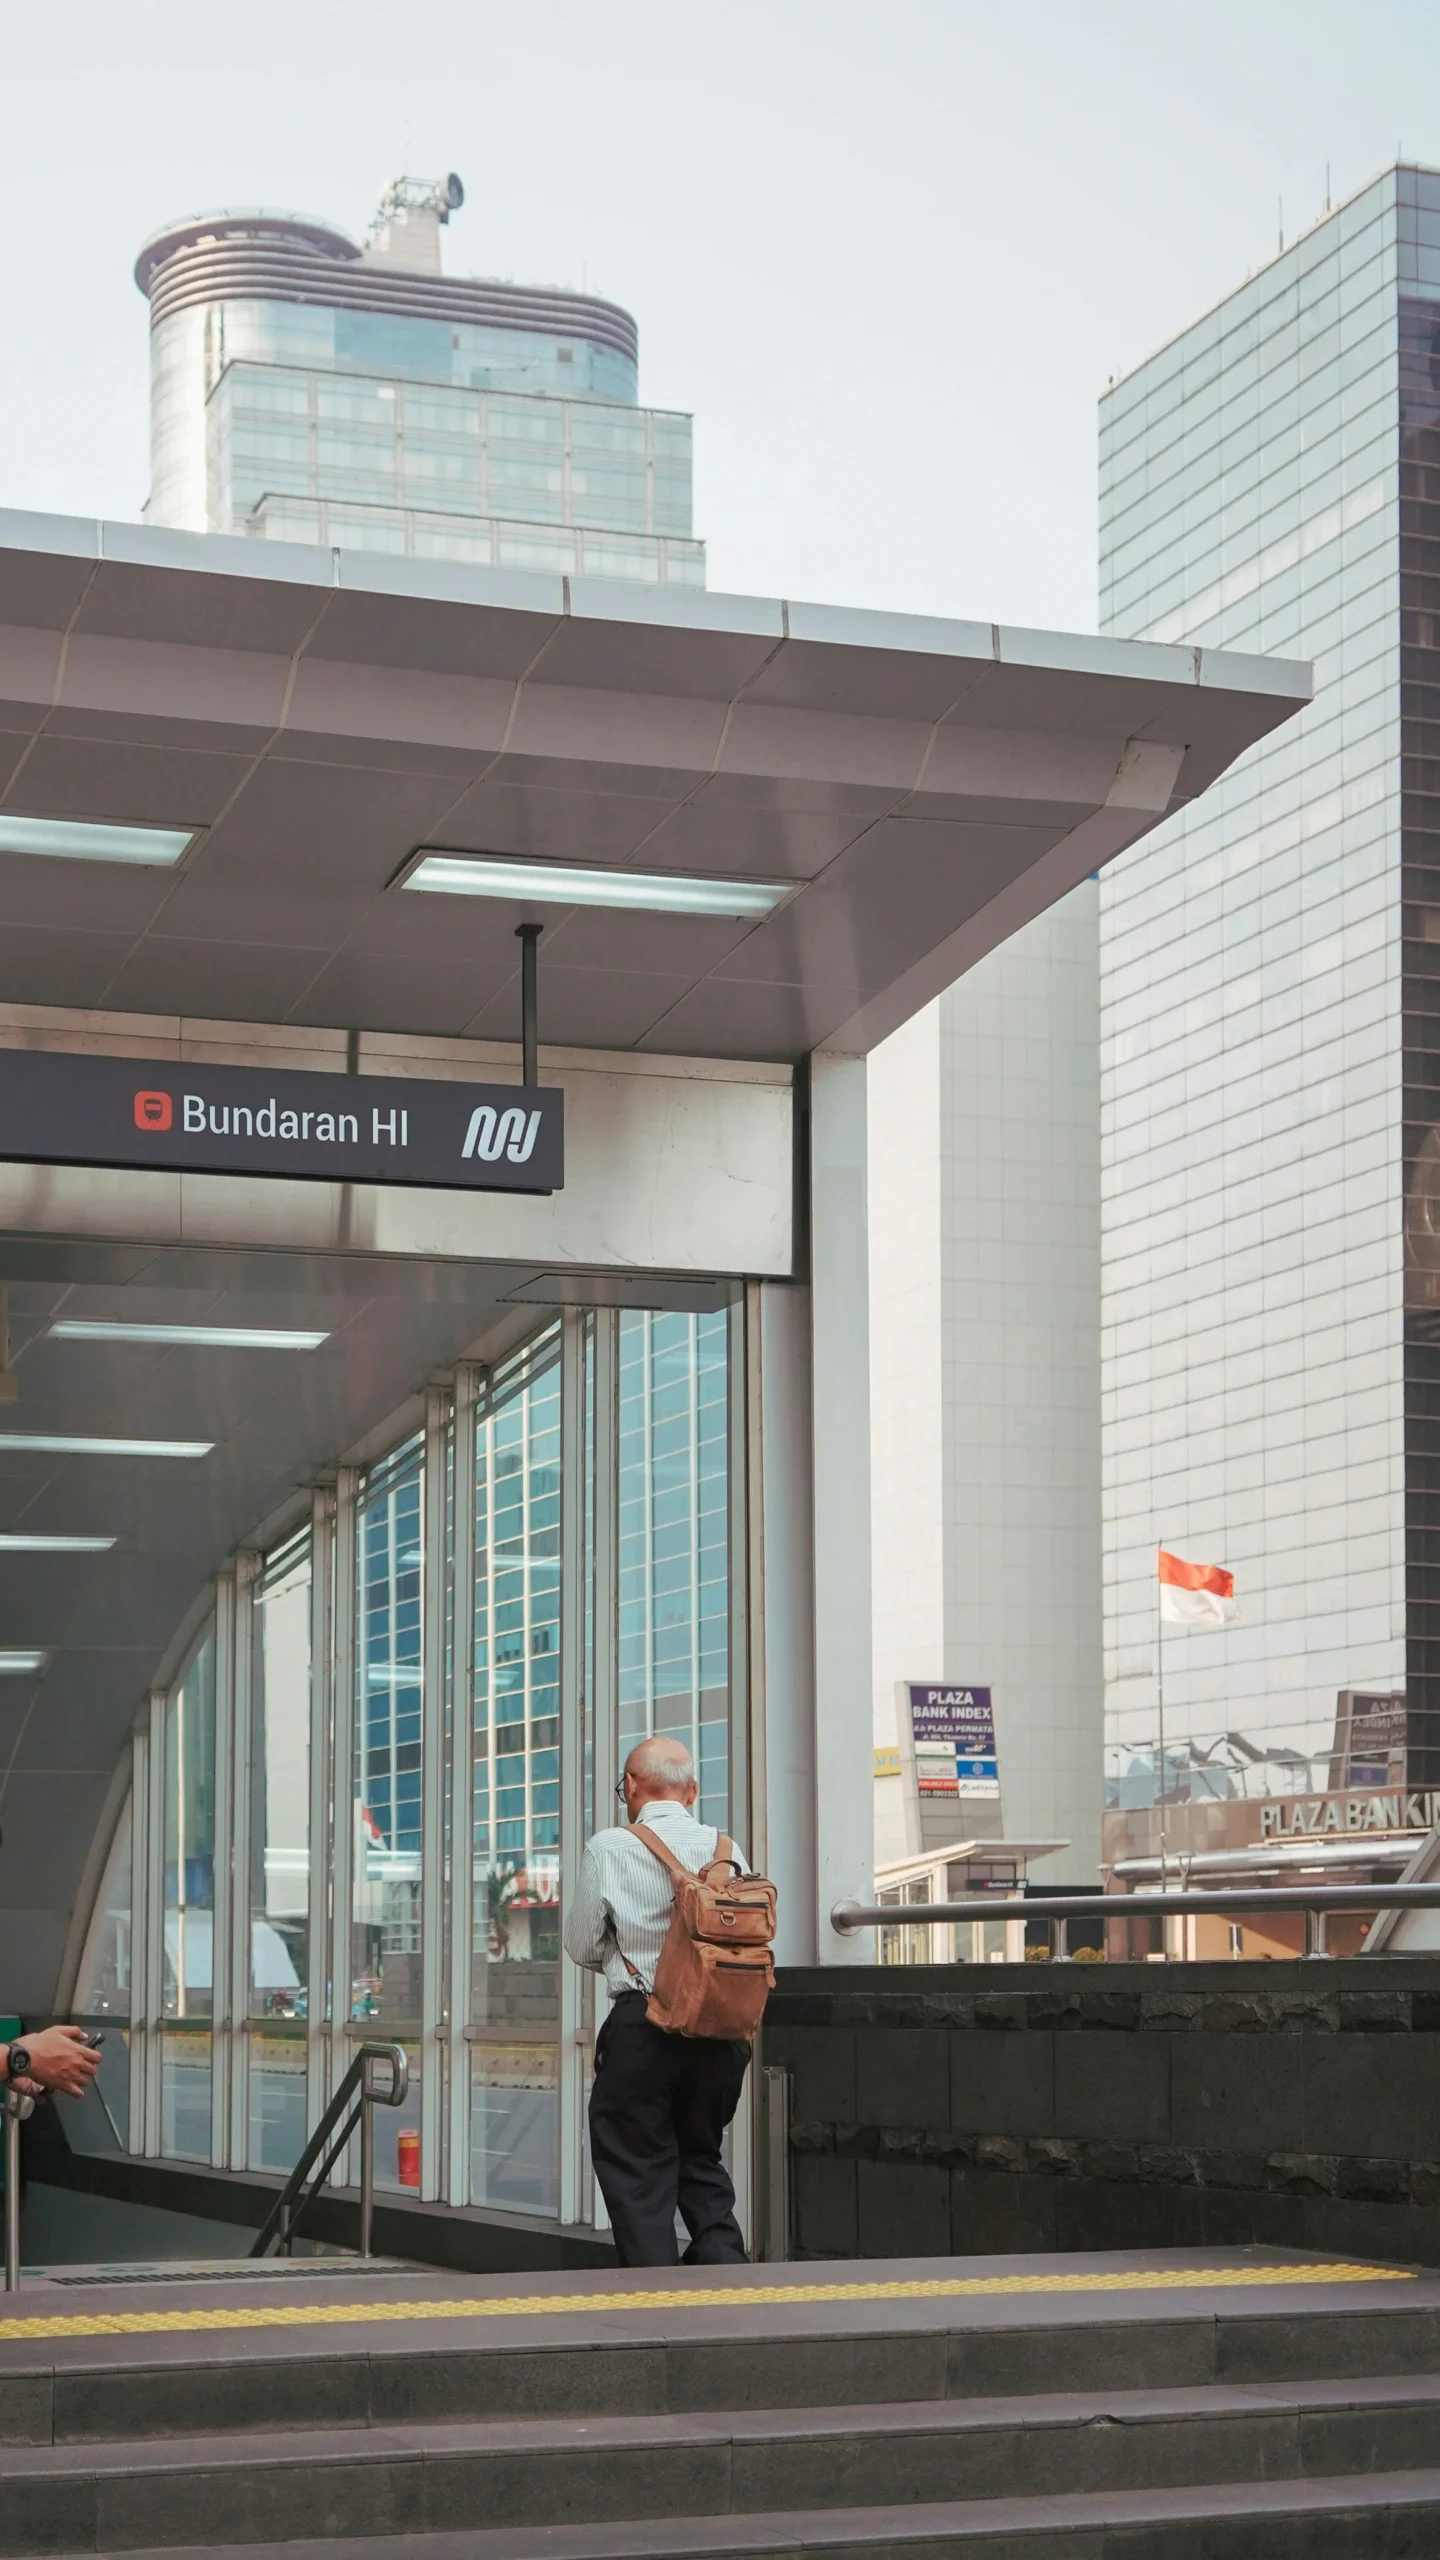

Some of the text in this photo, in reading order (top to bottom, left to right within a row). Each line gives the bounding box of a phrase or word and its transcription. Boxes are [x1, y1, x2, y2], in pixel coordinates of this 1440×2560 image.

[183, 1094, 408, 1146] Bundaran HI
[928, 1691, 974, 1705] PLAZA
[913, 1706, 991, 1720] BANK INDEX
[927, 1724, 954, 1733] PLAZA
[955, 1725, 993, 1734] PERMATA
[1260, 1800, 1345, 1837] PLAZA
[1346, 1793, 1426, 1831] BANK
